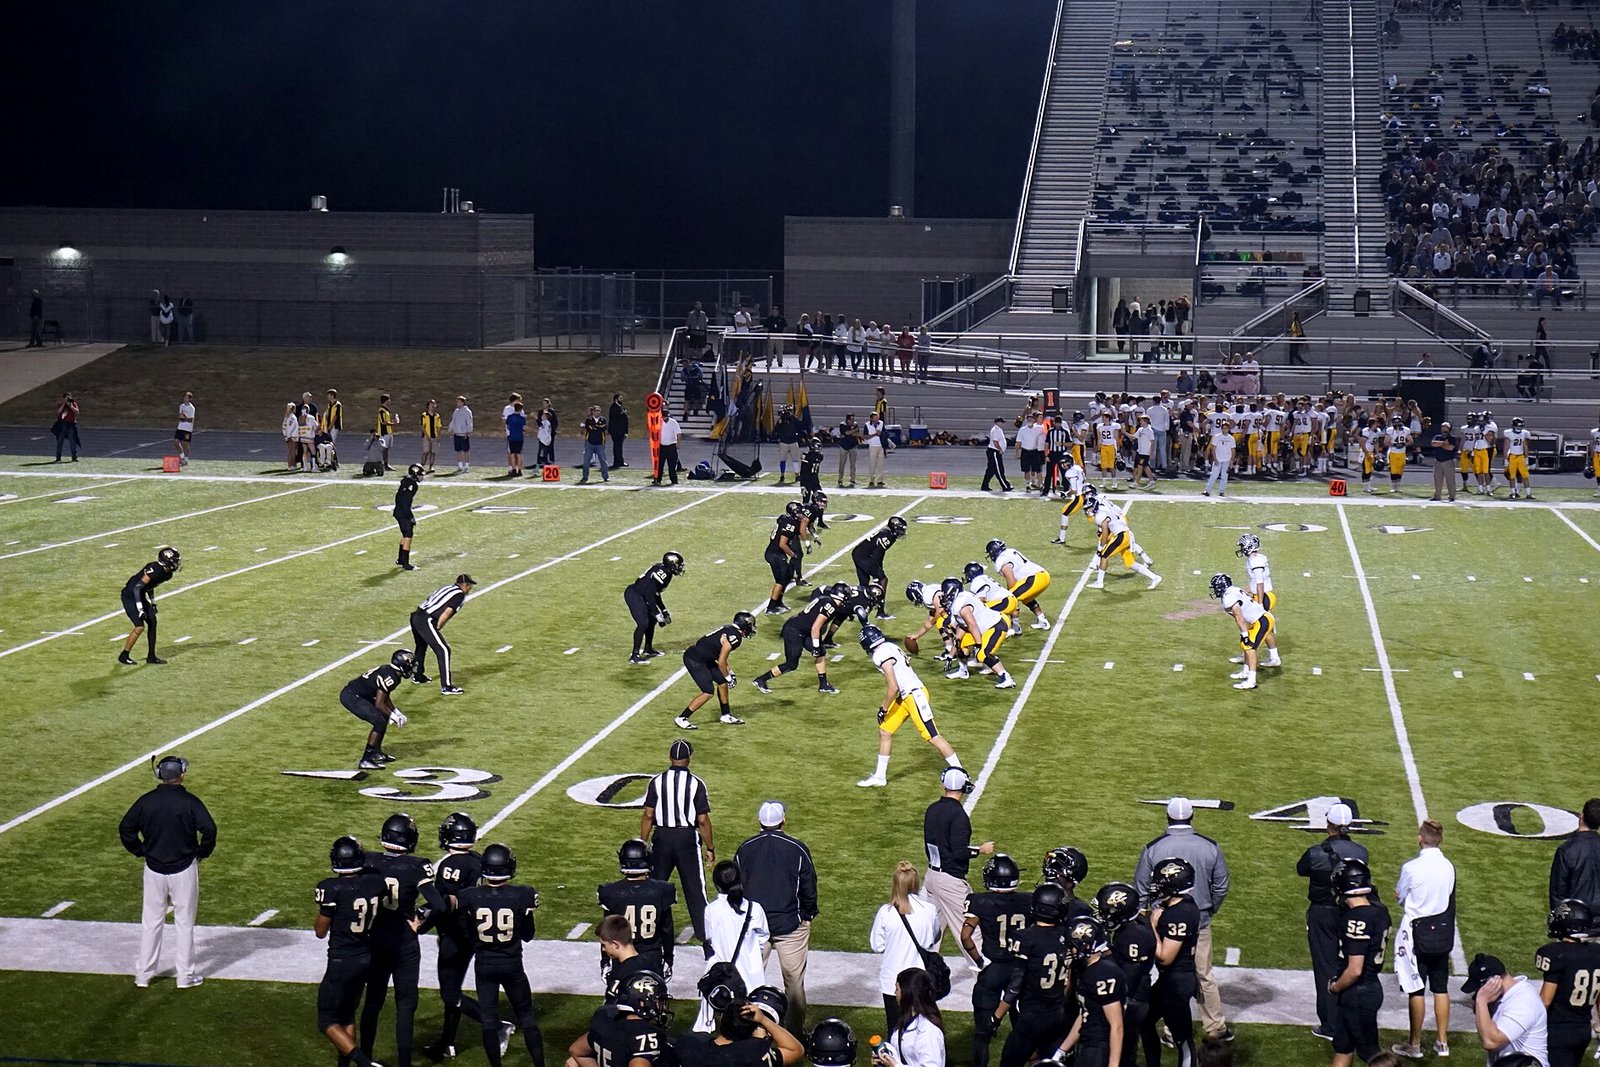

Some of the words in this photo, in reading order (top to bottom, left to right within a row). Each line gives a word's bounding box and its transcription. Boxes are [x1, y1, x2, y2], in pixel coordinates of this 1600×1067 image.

[1047, 392, 1055, 407] 1
[545, 467, 559, 479] 20
[933, 475, 947, 486] 30
[1331, 482, 1345, 493] 40
[656, 569, 668, 580] 20
[823, 603, 836, 615] 90
[728, 635, 739, 645] 41
[384, 675, 395, 687] 10
[443, 866, 461, 882] 64
[315, 888, 326, 902] 31
[350, 896, 379, 933] 31
[624, 904, 657, 940] 48
[476, 907, 514, 943] 29
[1168, 922, 1187, 937] 32
[1347, 919, 1367, 935] 52
[1008, 937, 1021, 953] 34
[1129, 943, 1139, 958] 6
[1535, 954, 1551, 972] 86
[1096, 978, 1116, 996] 27
[635, 1032, 659, 1052] 75
